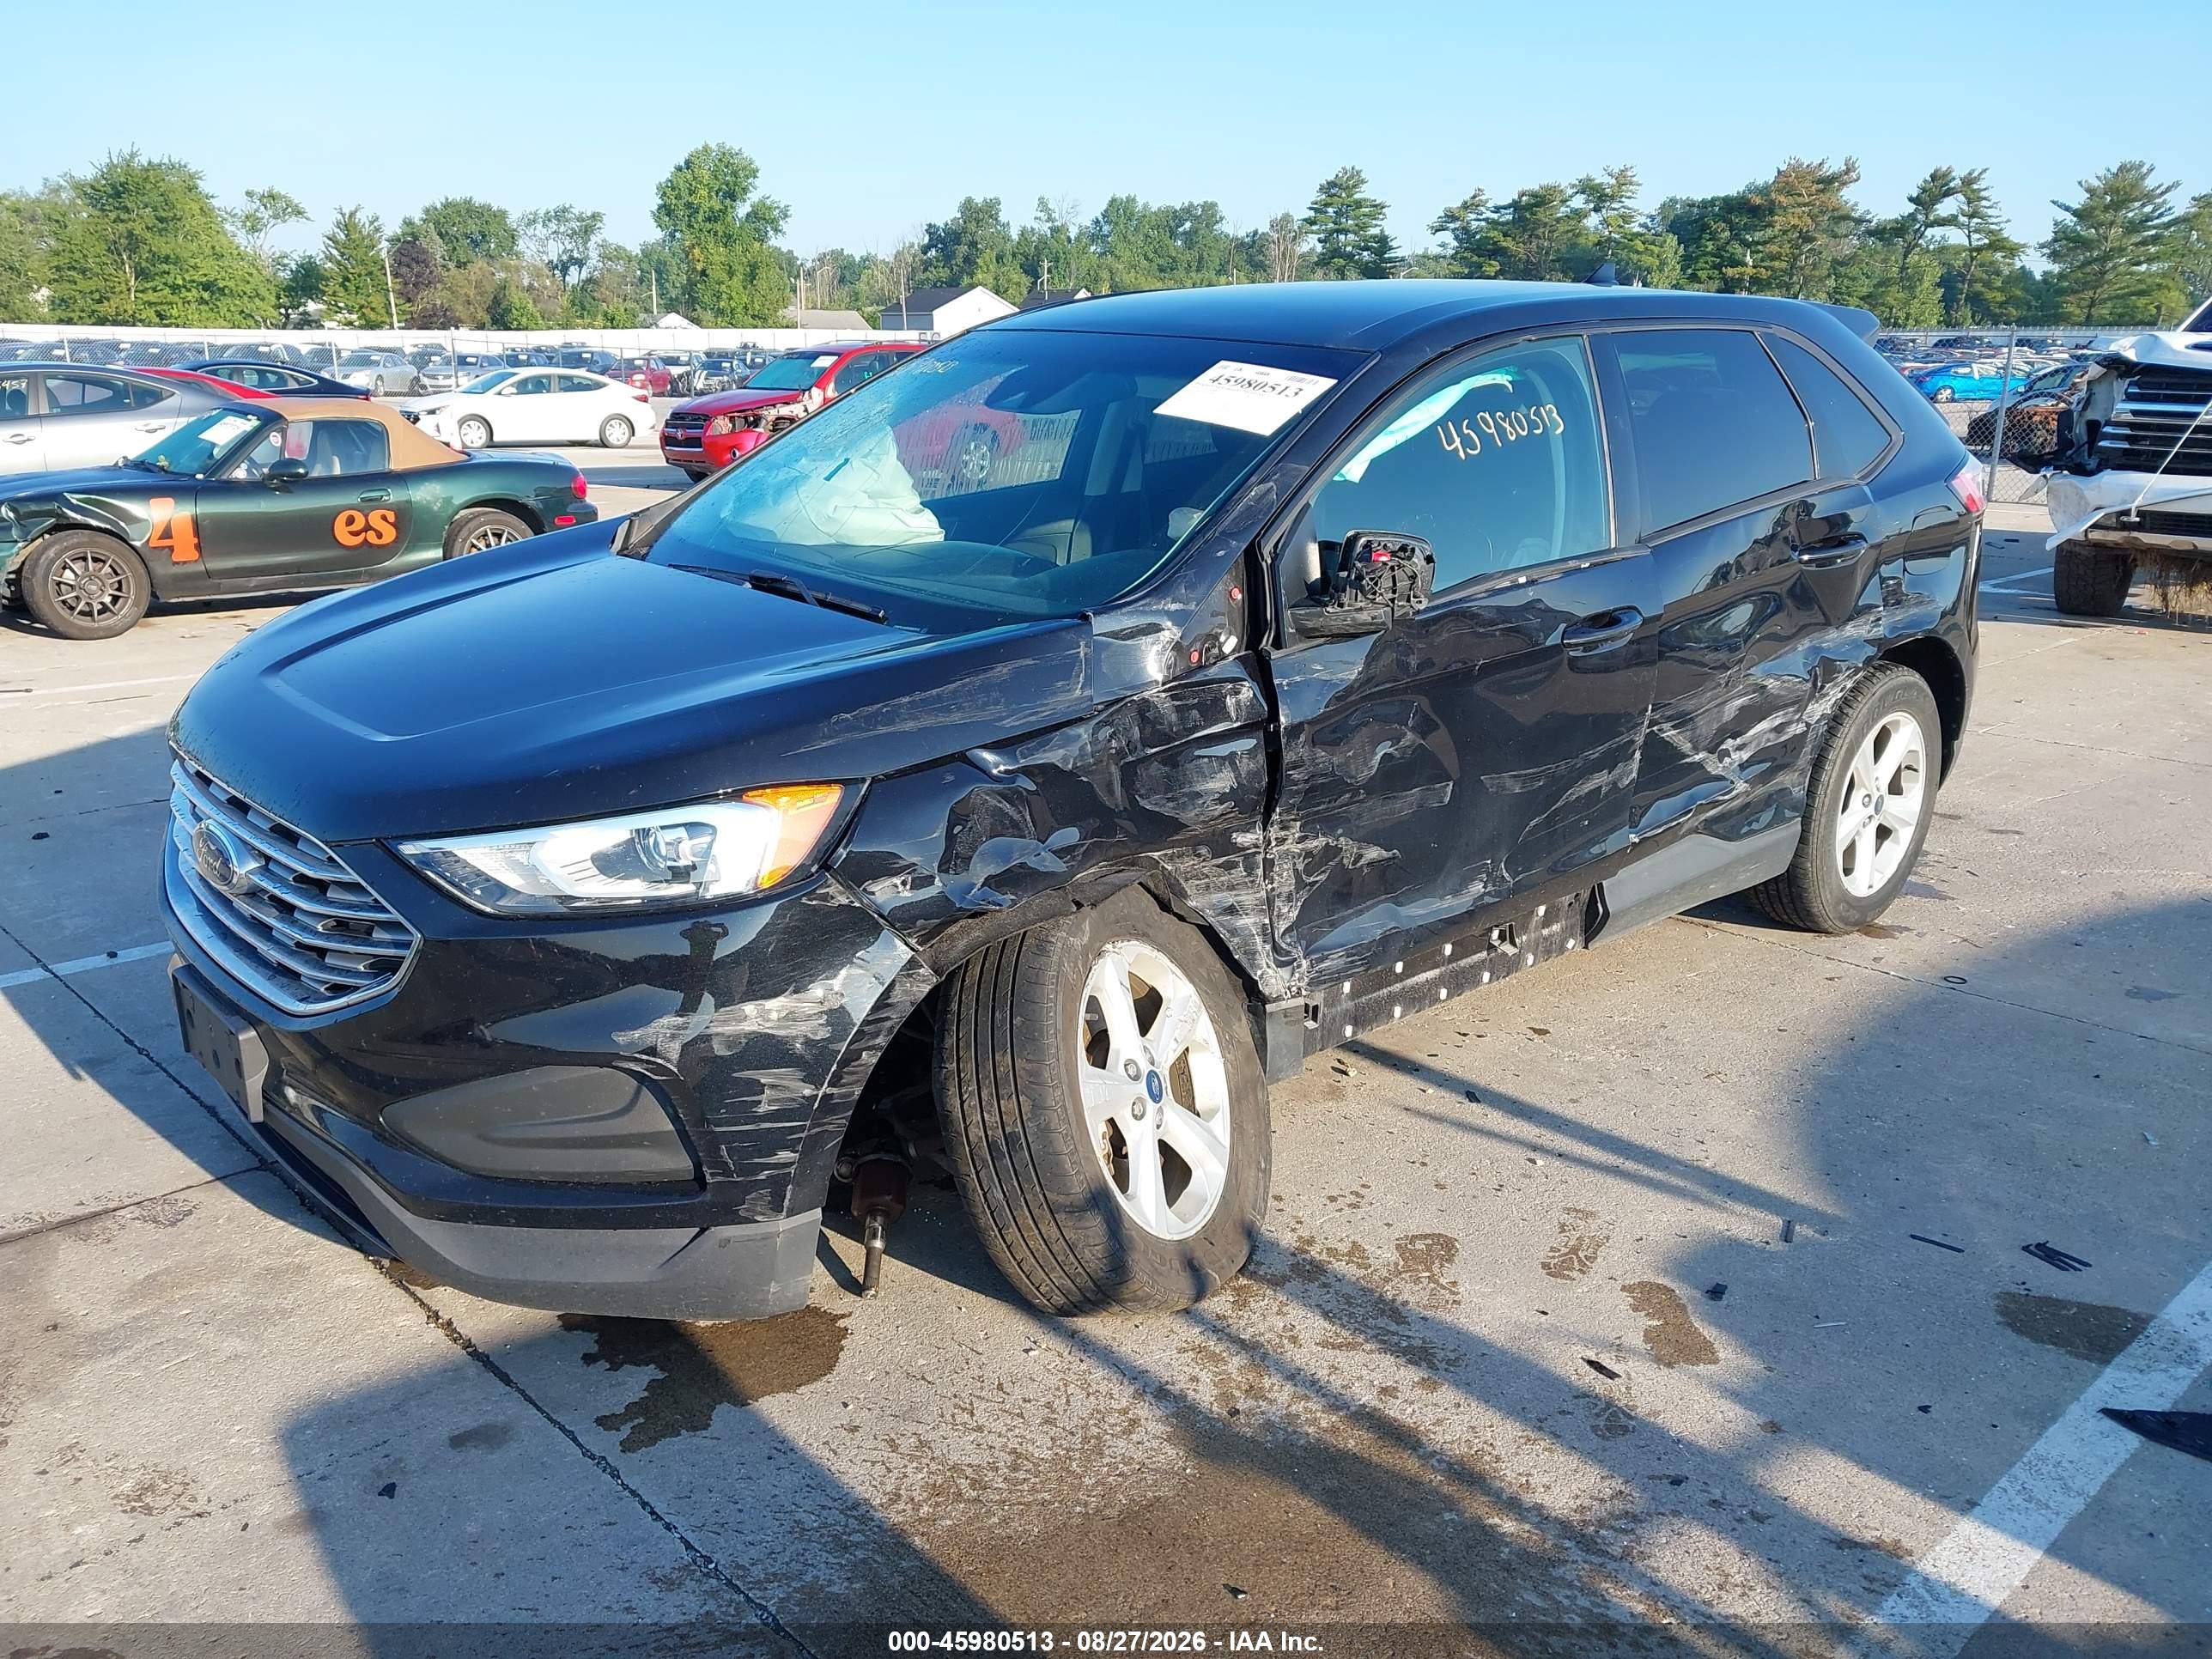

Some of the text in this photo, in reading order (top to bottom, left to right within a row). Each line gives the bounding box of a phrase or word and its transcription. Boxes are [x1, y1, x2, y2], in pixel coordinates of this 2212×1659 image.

[0, 379, 28, 391] 457
[1209, 374, 1304, 398] 45980513
[1437, 404, 1565, 460] 45980513
[149, 497, 398, 562] 4 es
